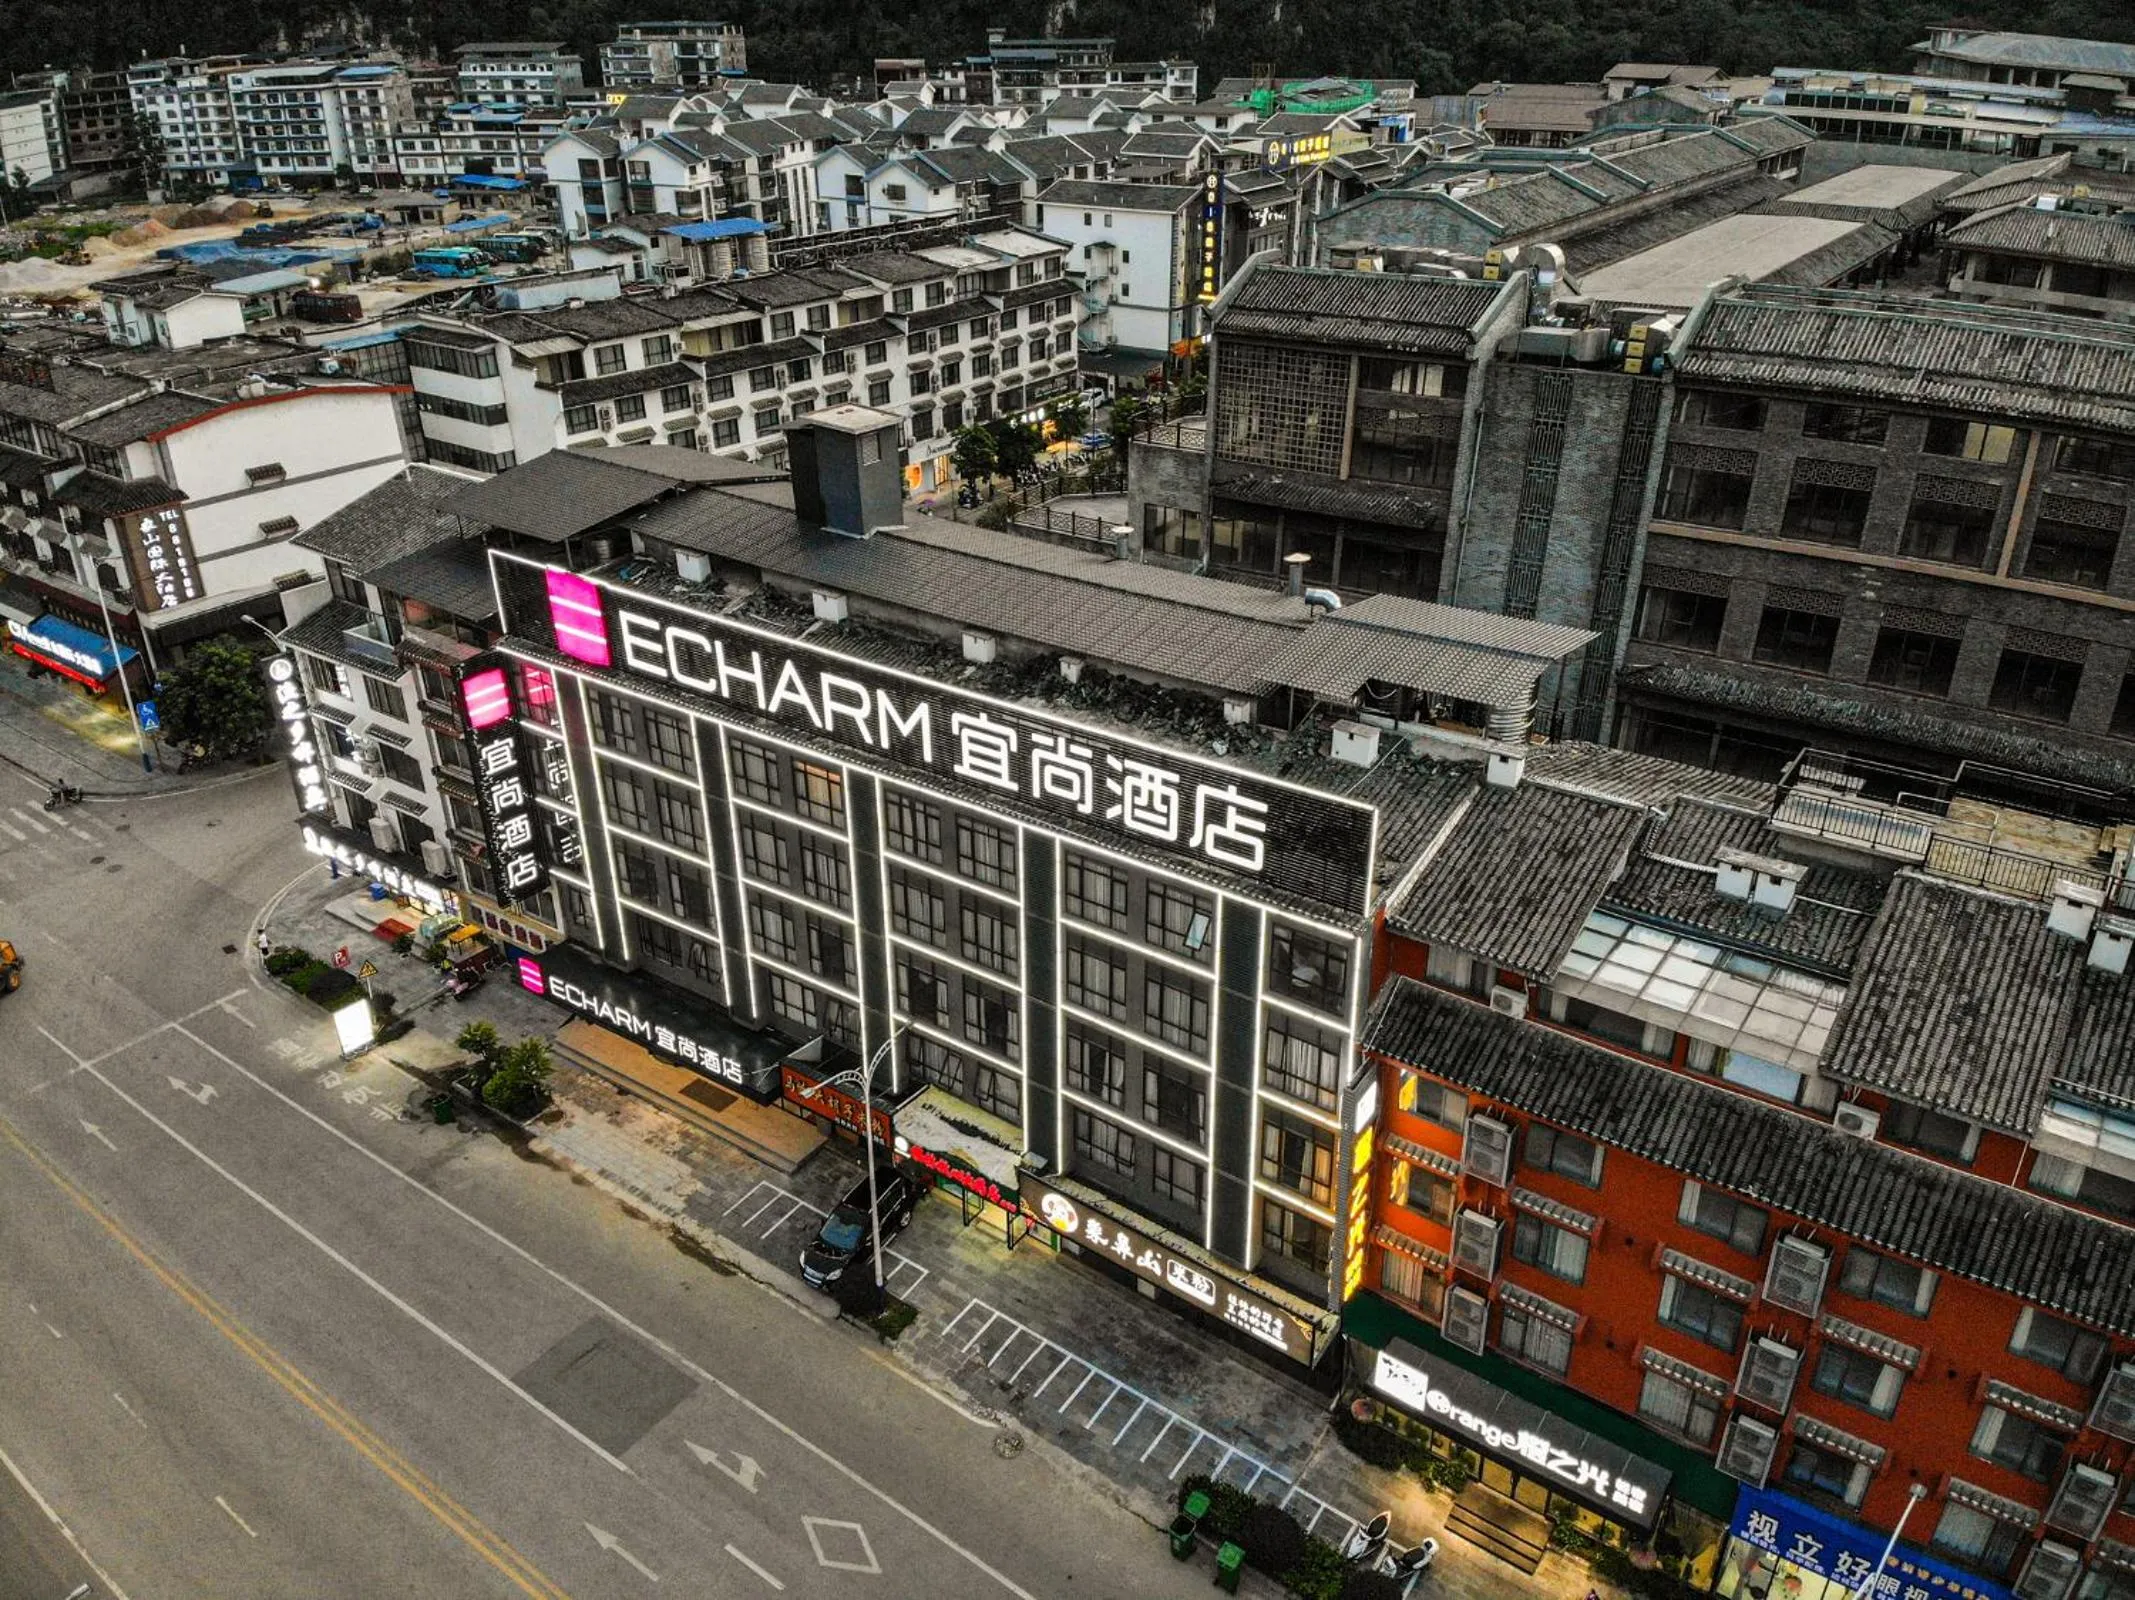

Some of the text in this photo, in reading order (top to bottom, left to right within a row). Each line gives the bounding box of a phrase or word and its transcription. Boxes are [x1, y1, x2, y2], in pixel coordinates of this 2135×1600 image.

[159, 509, 180, 522] TEL
[618, 609, 1270, 872] ECHARM 宜尚酒店
[480, 737, 539, 890] 宜尚酒店
[548, 974, 743, 1085] ECHARM 宜尚酒店
[1746, 1509, 1872, 1583] 视立好
